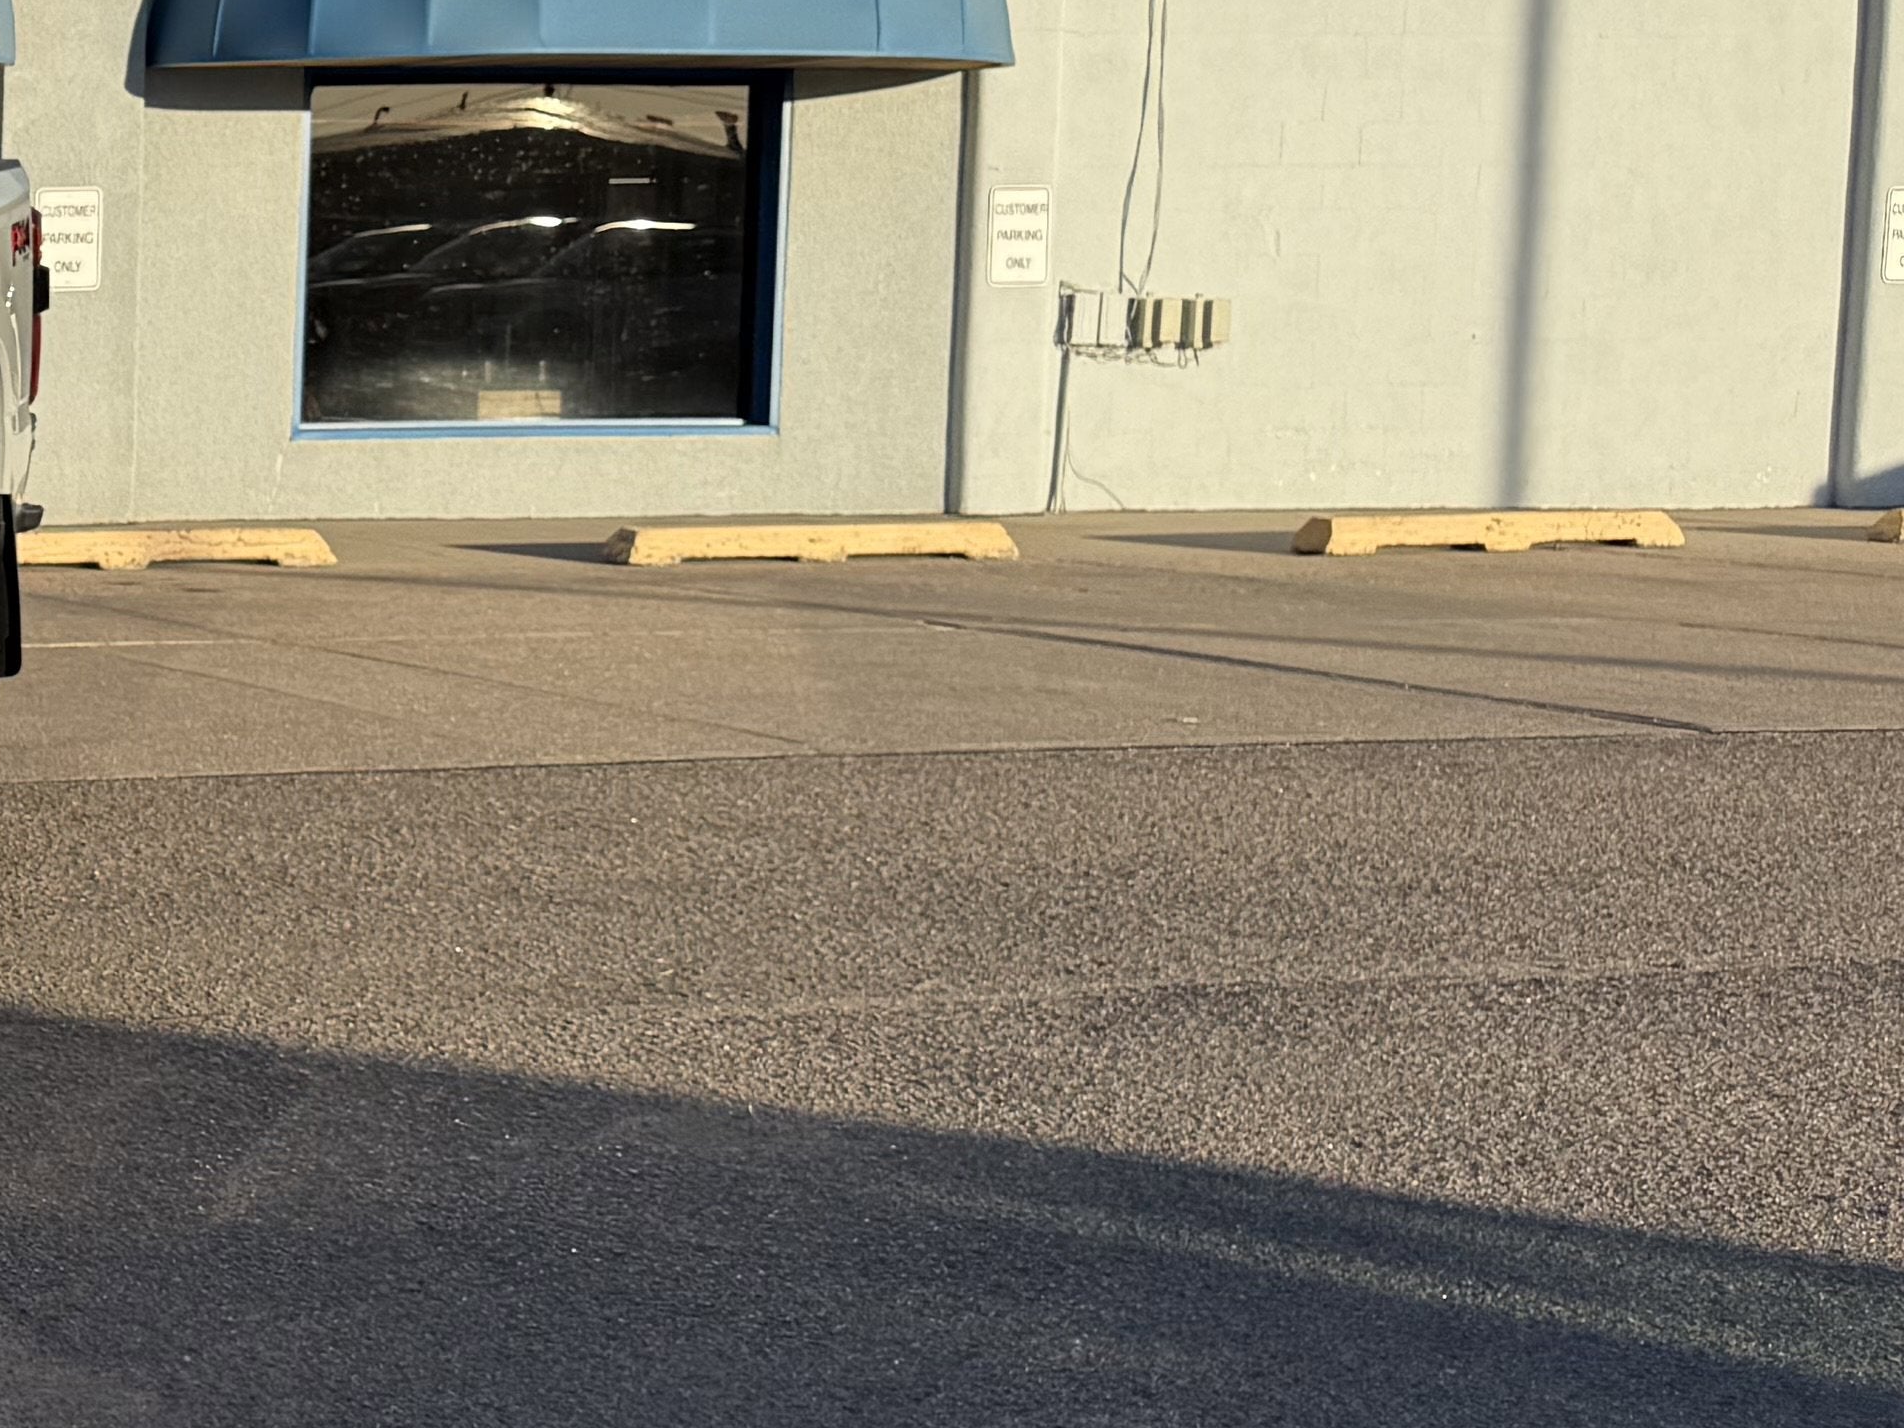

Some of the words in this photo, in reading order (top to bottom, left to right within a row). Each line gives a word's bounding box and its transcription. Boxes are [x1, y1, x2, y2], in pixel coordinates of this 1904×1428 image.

[42, 204, 96, 217] CUSTOMER
[995, 203, 1048, 215] CUSTOMER
[996, 229, 1043, 241] PARKING
[54, 260, 81, 272] ONLY
[1005, 257, 1032, 269] ONLY
